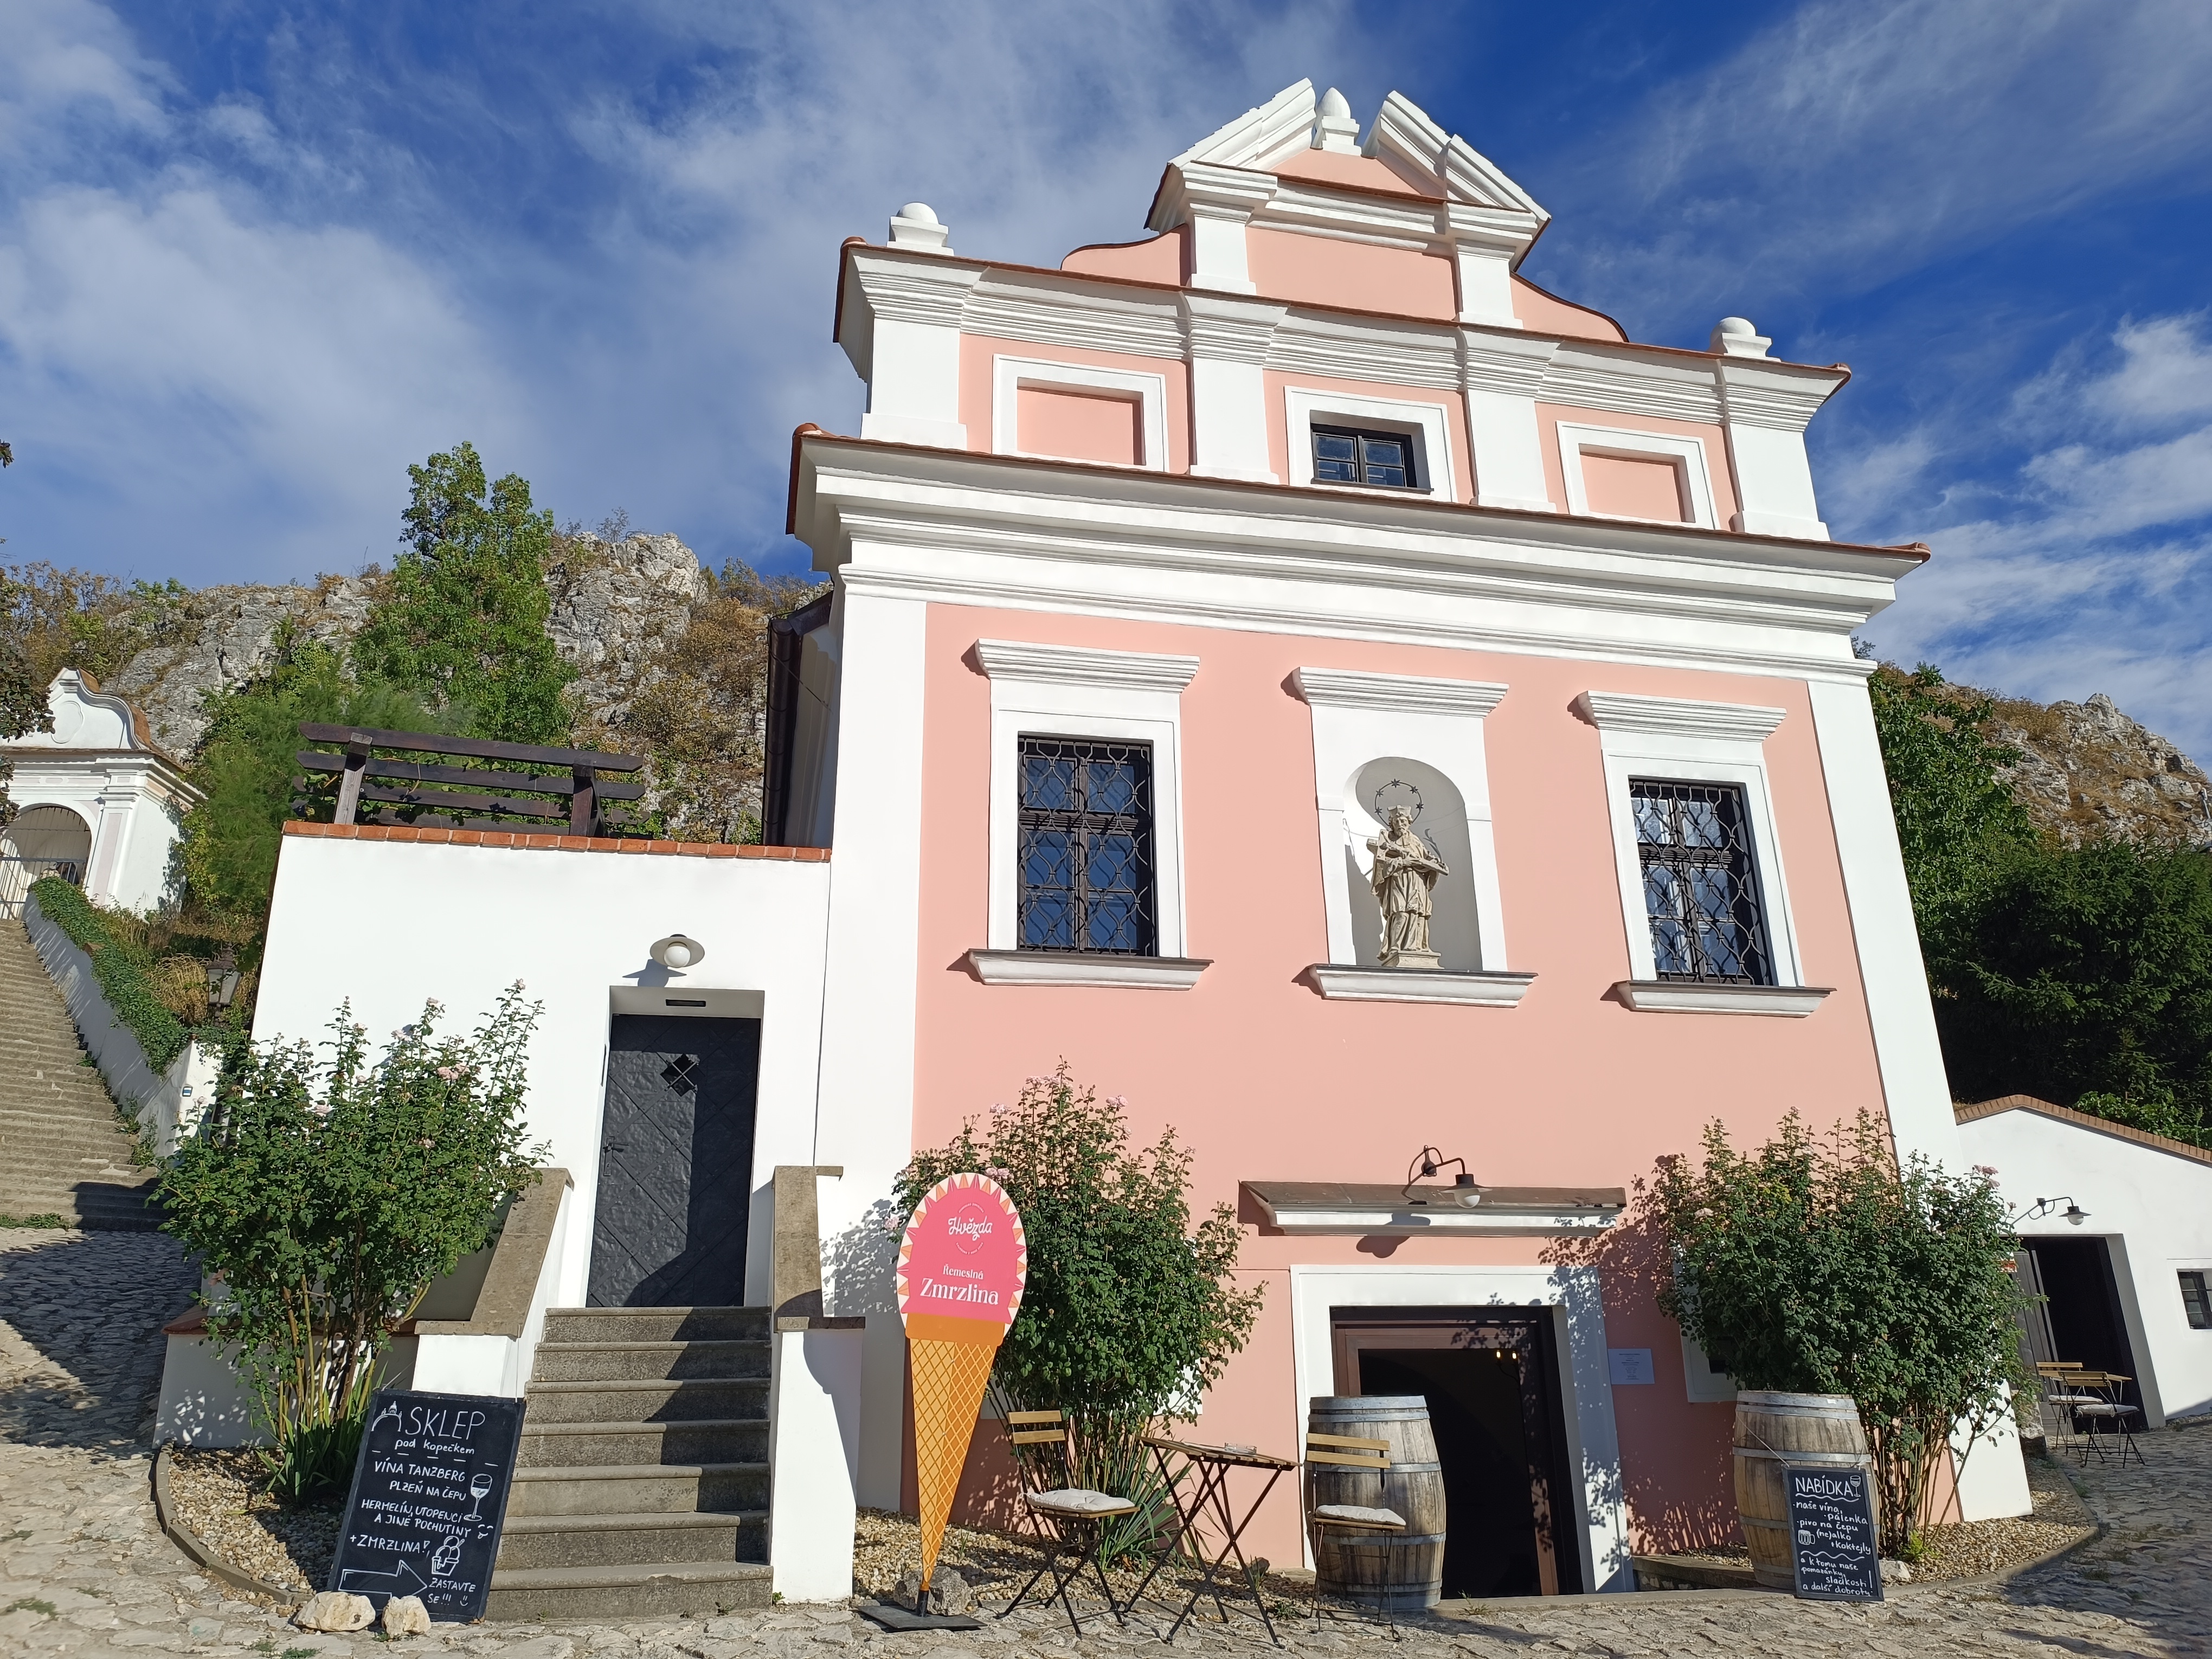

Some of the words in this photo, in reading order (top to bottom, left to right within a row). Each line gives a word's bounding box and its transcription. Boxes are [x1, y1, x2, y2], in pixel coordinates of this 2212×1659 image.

[948, 1215, 993, 1242] Hvězda
[942, 1263, 983, 1279] Řemeslná
[920, 1277, 999, 1305] Zmrzlina
[406, 1406, 486, 1440] SKLEP
[395, 1438, 416, 1450] pod
[423, 1439, 475, 1455] kopečkem
[375, 1457, 403, 1474] VÍNA
[409, 1464, 466, 1482] TANZBERG
[426, 1487, 440, 1497] NA
[442, 1486, 466, 1501] ČEPU
[1795, 1475, 1854, 1496] NABÍDKA
[374, 1513, 382, 1523] A
[385, 1514, 411, 1527] JINÉ
[415, 1518, 471, 1538] POCHUTINY
[1836, 1521, 1859, 1534] čepu
[1816, 1528, 1851, 1540] (ne)alko
[1816, 1558, 1836, 1568] tomu
[429, 1577, 476, 1593] ZASTAVTE
[1811, 1581, 1832, 1592] další
